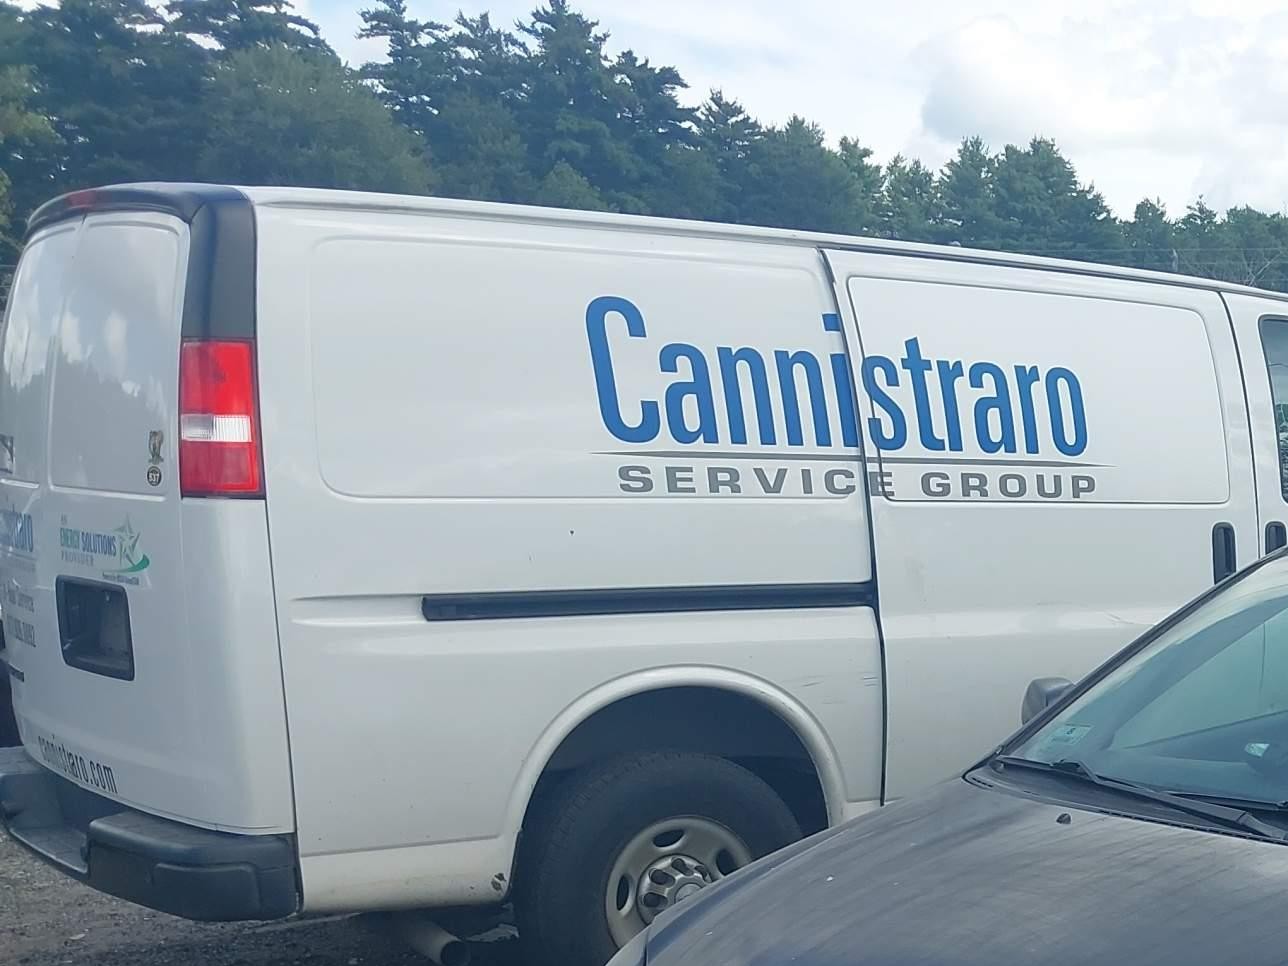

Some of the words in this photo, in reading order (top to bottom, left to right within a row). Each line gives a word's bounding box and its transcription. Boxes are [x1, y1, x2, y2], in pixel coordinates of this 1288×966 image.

[585, 296, 1088, 457] Cannistraro
[618, 465, 895, 498] SERVICE
[921, 471, 1097, 499] GROUP
[81, 531, 117, 557] SOLUTIONS
